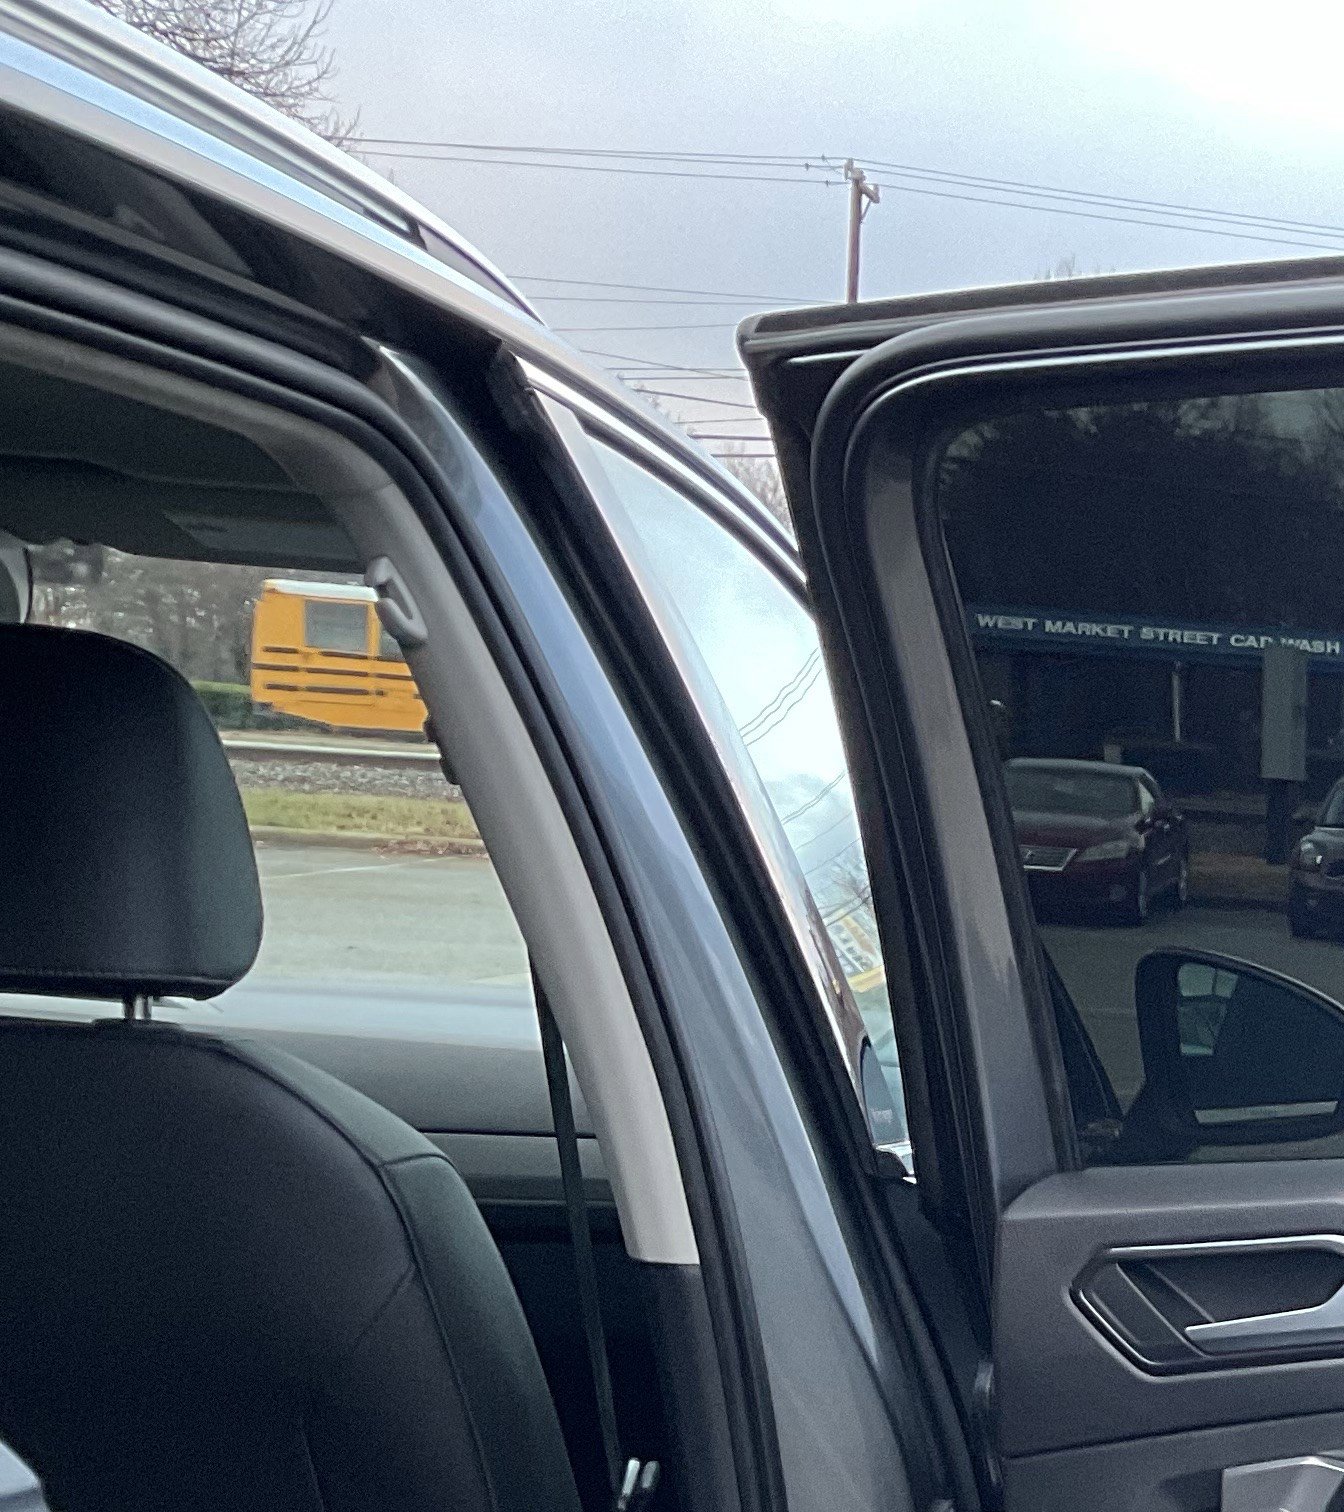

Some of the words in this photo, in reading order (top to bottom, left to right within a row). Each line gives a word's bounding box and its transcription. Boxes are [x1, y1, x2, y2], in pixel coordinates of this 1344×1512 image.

[977, 613, 1038, 631] WEST
[1044, 620, 1134, 639] MARKET
[1140, 627, 1222, 645] STREET
